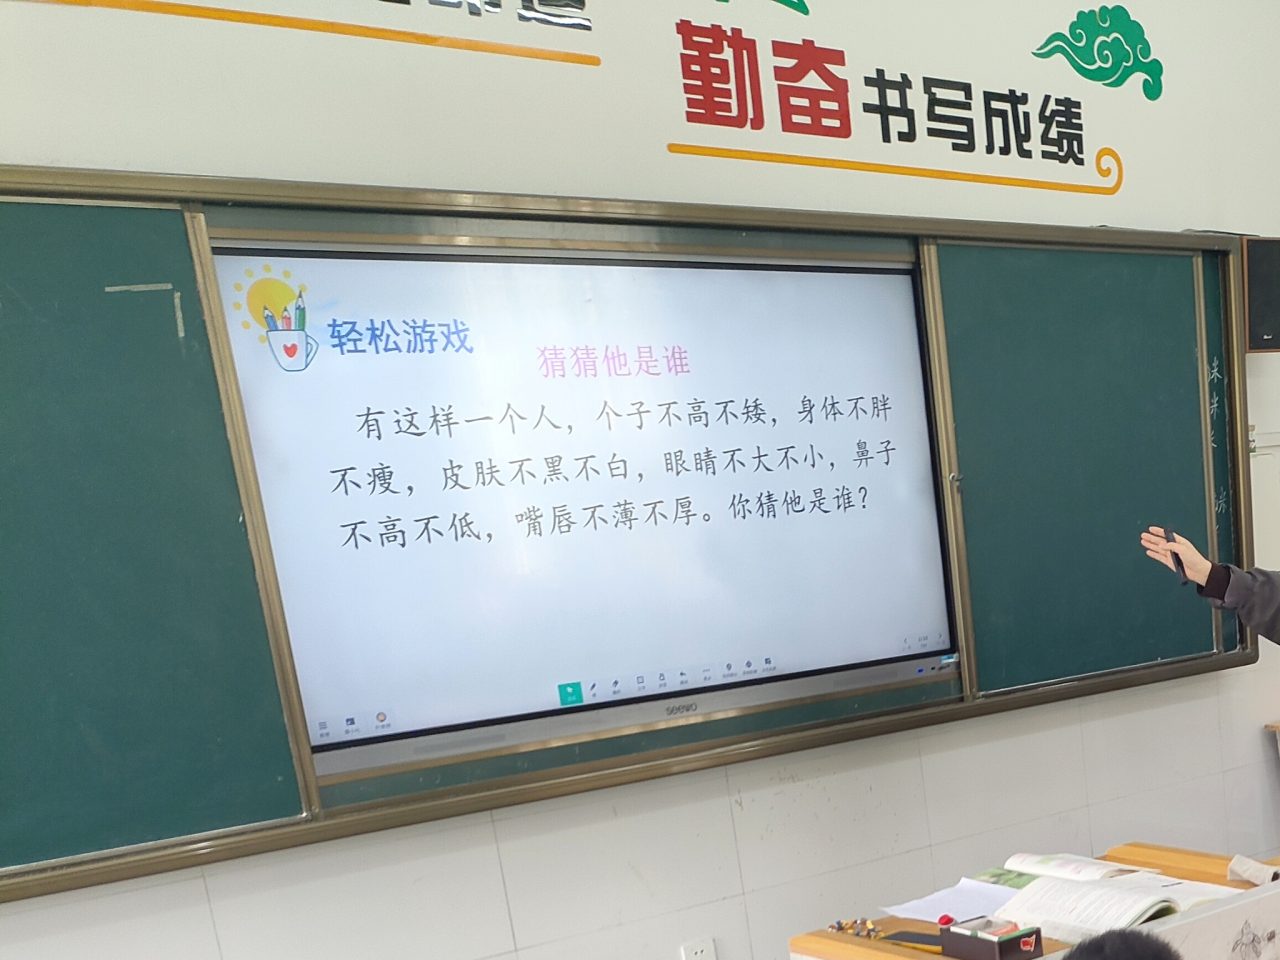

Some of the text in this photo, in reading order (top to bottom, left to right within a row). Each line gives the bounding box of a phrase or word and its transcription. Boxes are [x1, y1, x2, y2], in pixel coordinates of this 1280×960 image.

[675, 19, 1085, 166] 勤奋书写成绩
[327, 318, 474, 355] 轻松游戏
[537, 344, 692, 379] 猜猜他是谁
